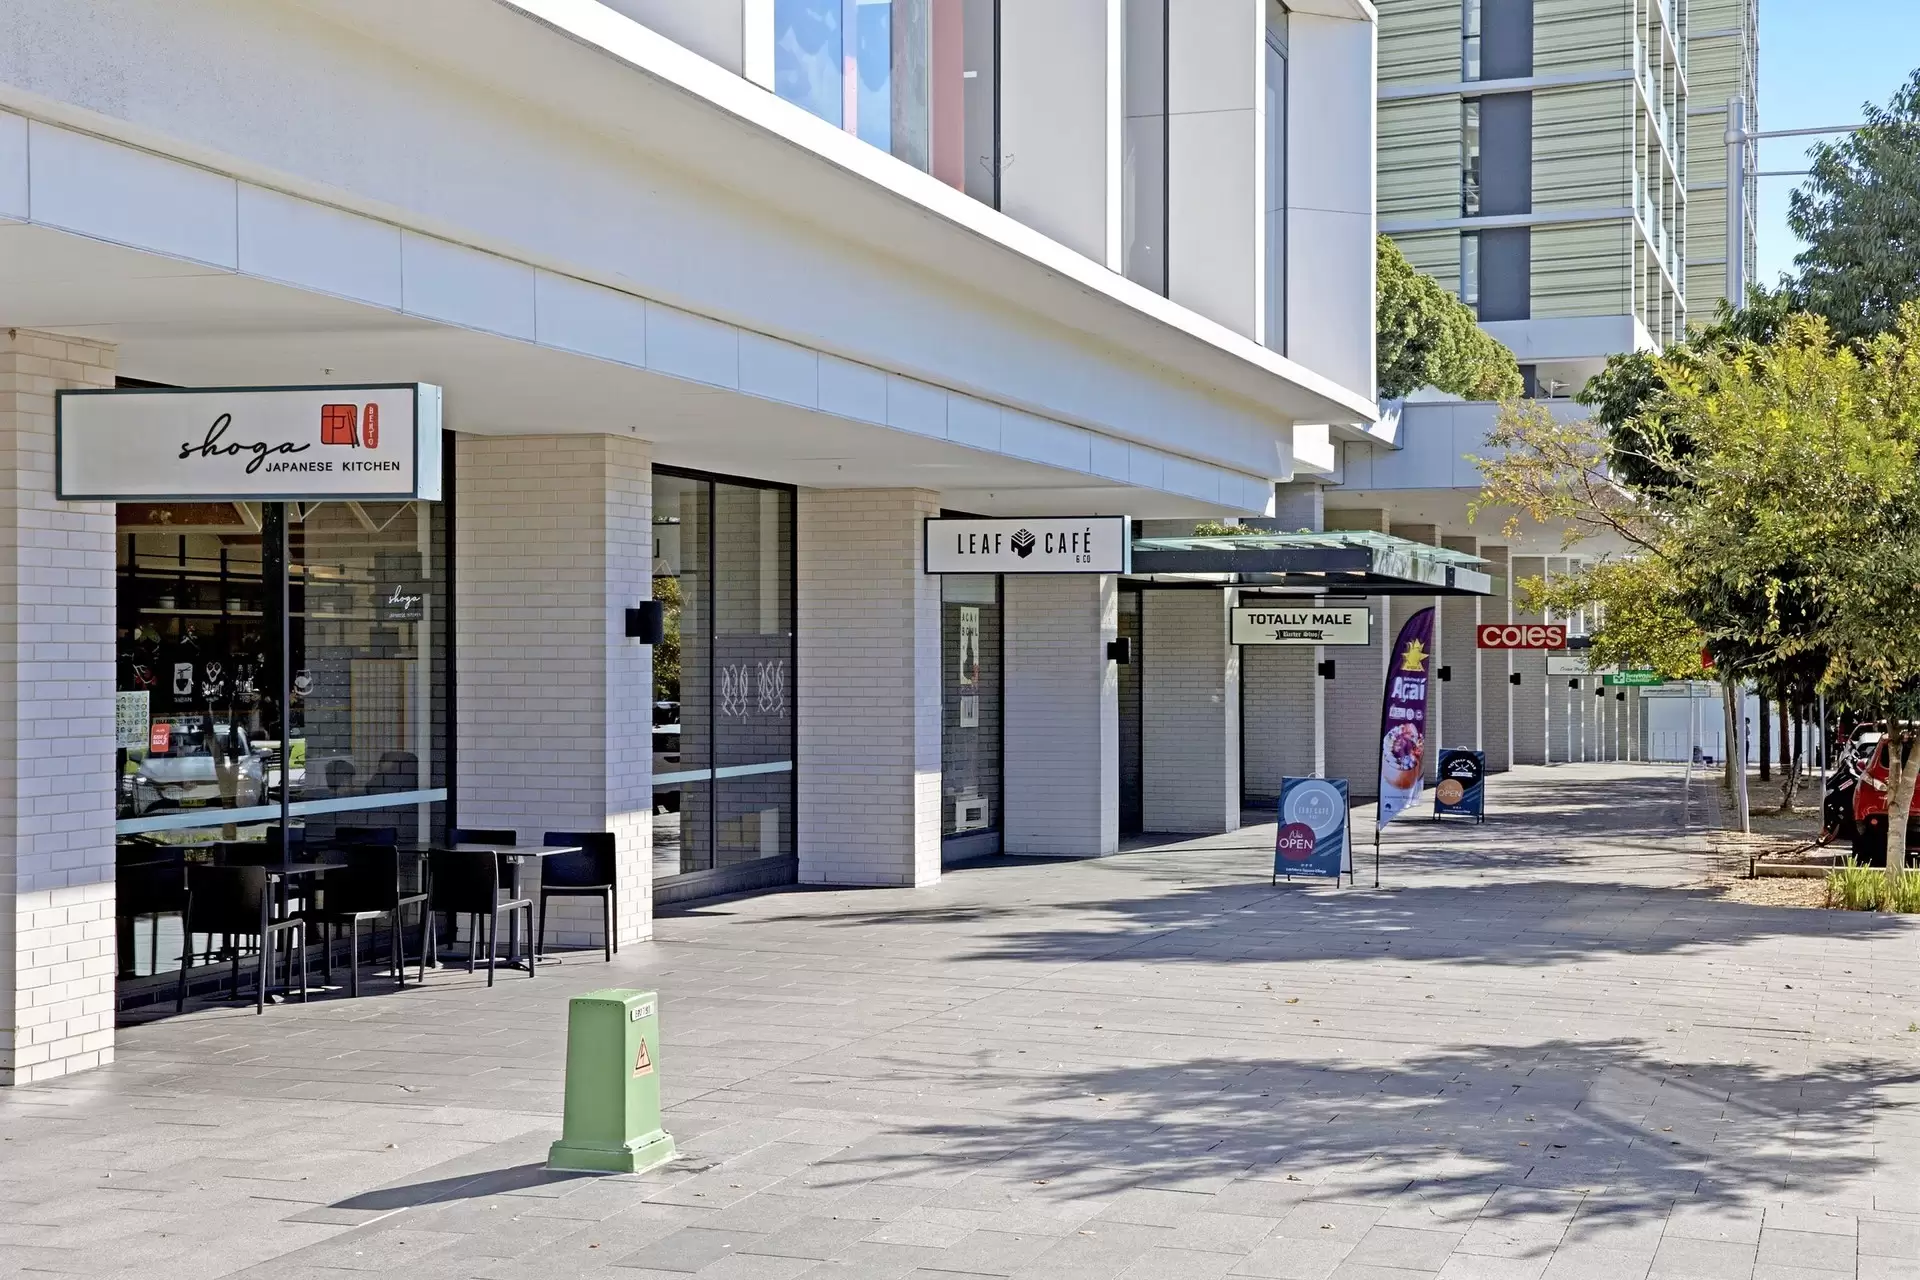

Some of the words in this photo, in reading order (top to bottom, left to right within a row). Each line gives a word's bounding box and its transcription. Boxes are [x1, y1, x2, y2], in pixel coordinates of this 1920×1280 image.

[367, 405, 375, 446] BENTO
[178, 412, 310, 474] shoga
[265, 461, 333, 472] JAPANESE
[342, 460, 401, 472] KITCHEN
[957, 533, 1002, 555] LEAF
[1045, 527, 1091, 554] CAFÉ
[388, 584, 421, 610] shoga
[1247, 613, 1308, 625] TOTALLY
[1312, 613, 1352, 625] MALE
[1482, 625, 1562, 647] coles
[1438, 789, 1462, 798] OPEN
[1279, 837, 1314, 850] OPEN
